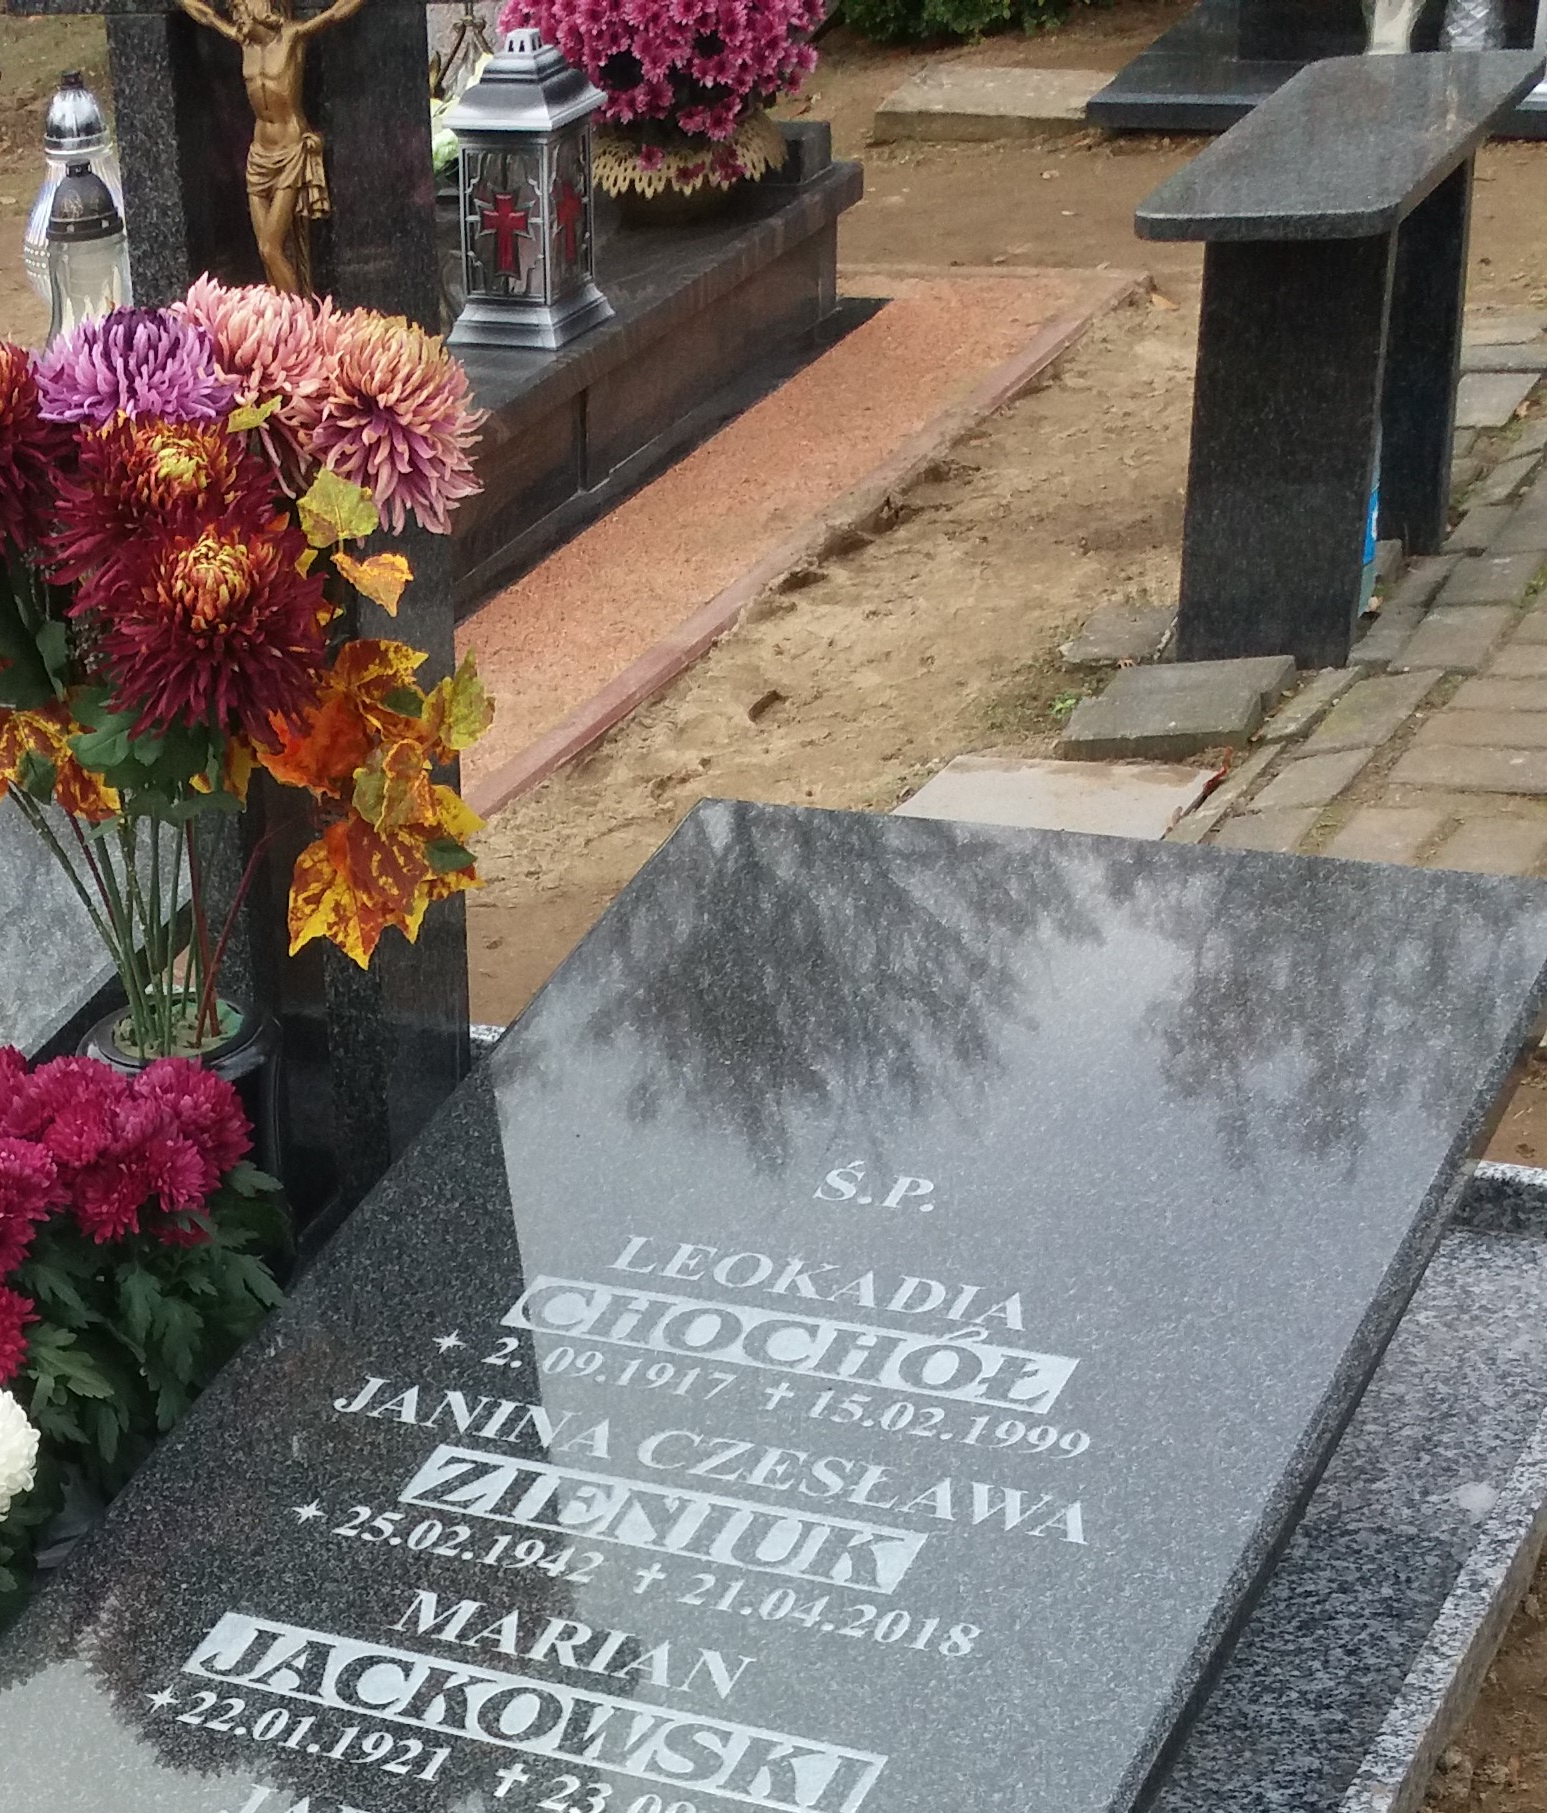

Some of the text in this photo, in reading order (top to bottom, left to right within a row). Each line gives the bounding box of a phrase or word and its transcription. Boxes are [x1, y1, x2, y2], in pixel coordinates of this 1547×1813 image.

[508, 1277, 1072, 1411] CHOCHÓŁ
[613, 1234, 1028, 1332] LEOKADIA
[334, 1376, 1090, 1546] JANINA CZESŁAWA
[542, 1346, 740, 1402] 09.1917
[808, 1389, 1092, 1460] 15.02.1999
[332, 1506, 984, 1658] 25.02.1942 21.04.2018
[402, 1449, 920, 1592] ZIENIUK
[388, 1588, 758, 1700] MARIAN
[174, 1690, 454, 1782] 22.01.1921
